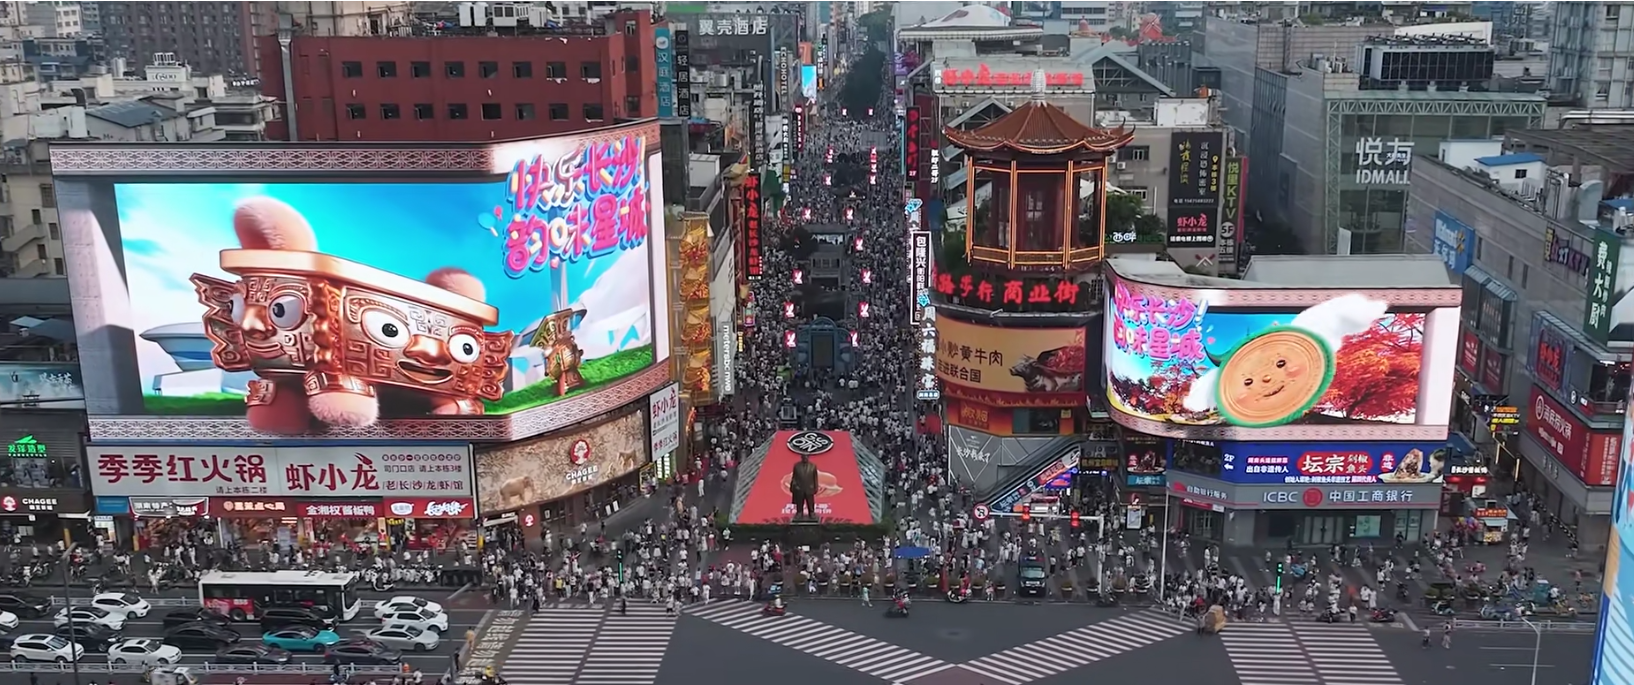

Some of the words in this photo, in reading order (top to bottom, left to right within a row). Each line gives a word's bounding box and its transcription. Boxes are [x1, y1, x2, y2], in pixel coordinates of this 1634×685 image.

[658, 52, 670, 107] 汉庭酒店
[1356, 136, 1415, 166] 悦方
[1226, 162, 1239, 219] 悦里KTV
[1356, 169, 1410, 184] IDMALL
[507, 187, 648, 273] 韵味星城
[1221, 225, 1235, 233] 5F
[921, 306, 937, 389] 周六福珠宝
[653, 387, 677, 419] 虾小龙
[98, 453, 267, 484] 季季红火锅
[285, 452, 381, 492] 虾小龙
[565, 465, 599, 481] CHAGEE
[1301, 454, 1345, 474] 坛宗
[1263, 491, 1299, 503] ICBC
[1329, 489, 1414, 503] 中国工商银行
